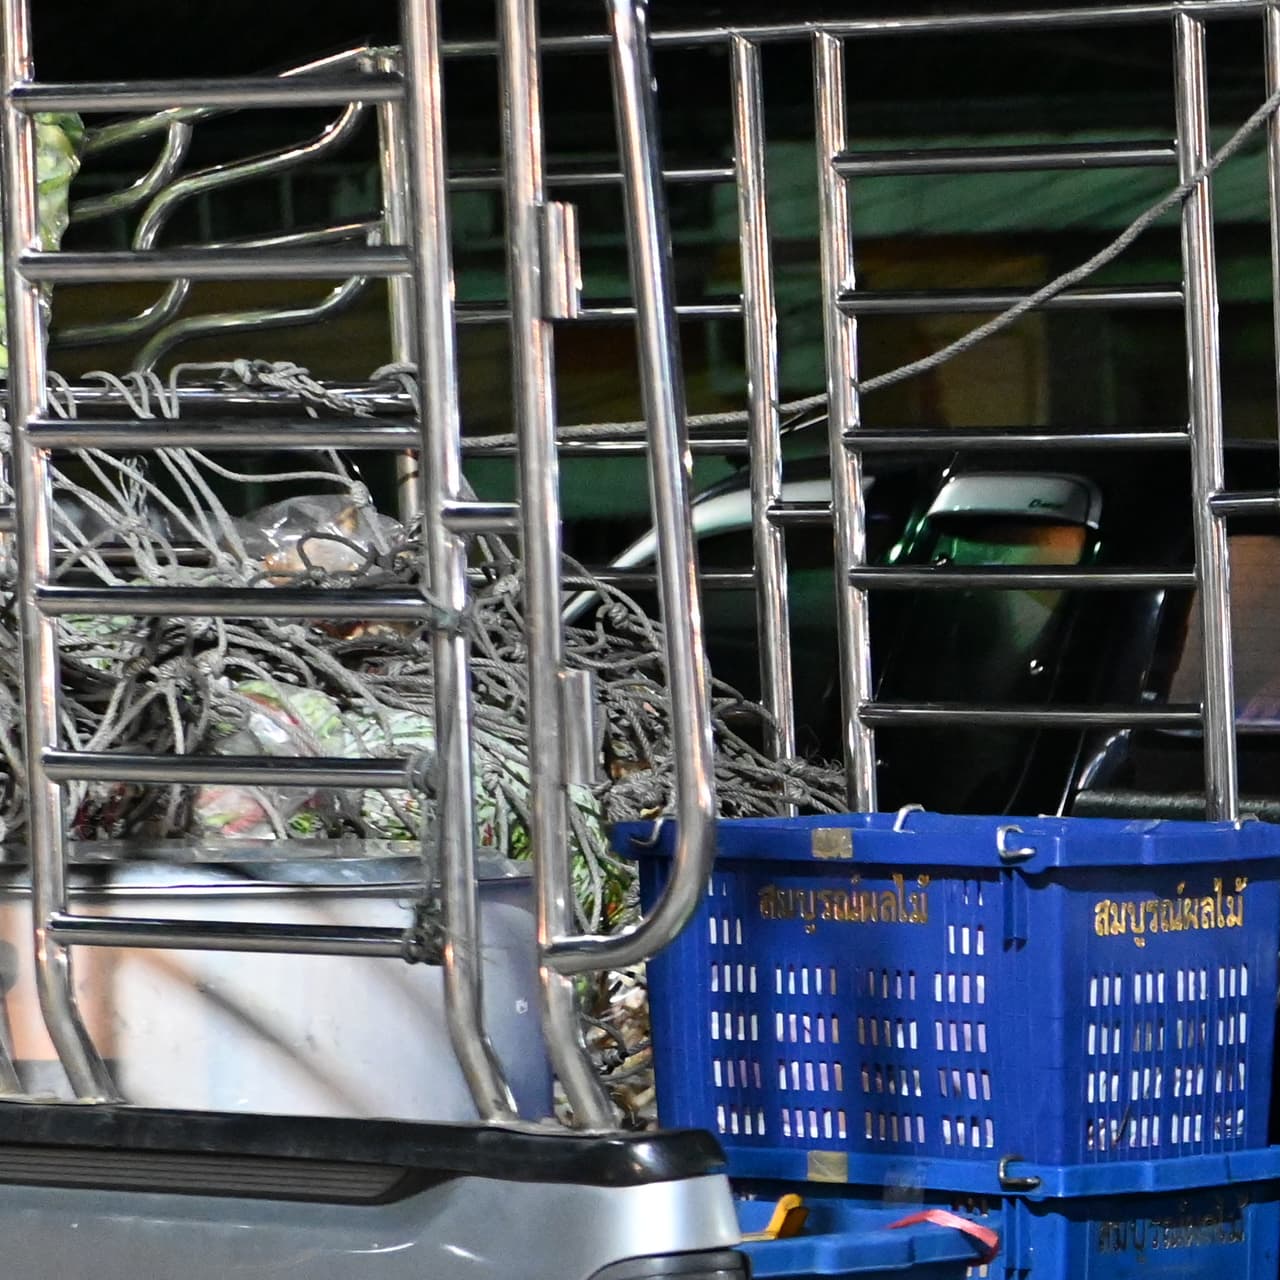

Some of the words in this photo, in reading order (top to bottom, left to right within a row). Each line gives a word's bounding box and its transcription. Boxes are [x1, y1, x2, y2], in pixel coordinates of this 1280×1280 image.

[1095, 877, 1248, 948] สมบูรณ์ผลไม้
